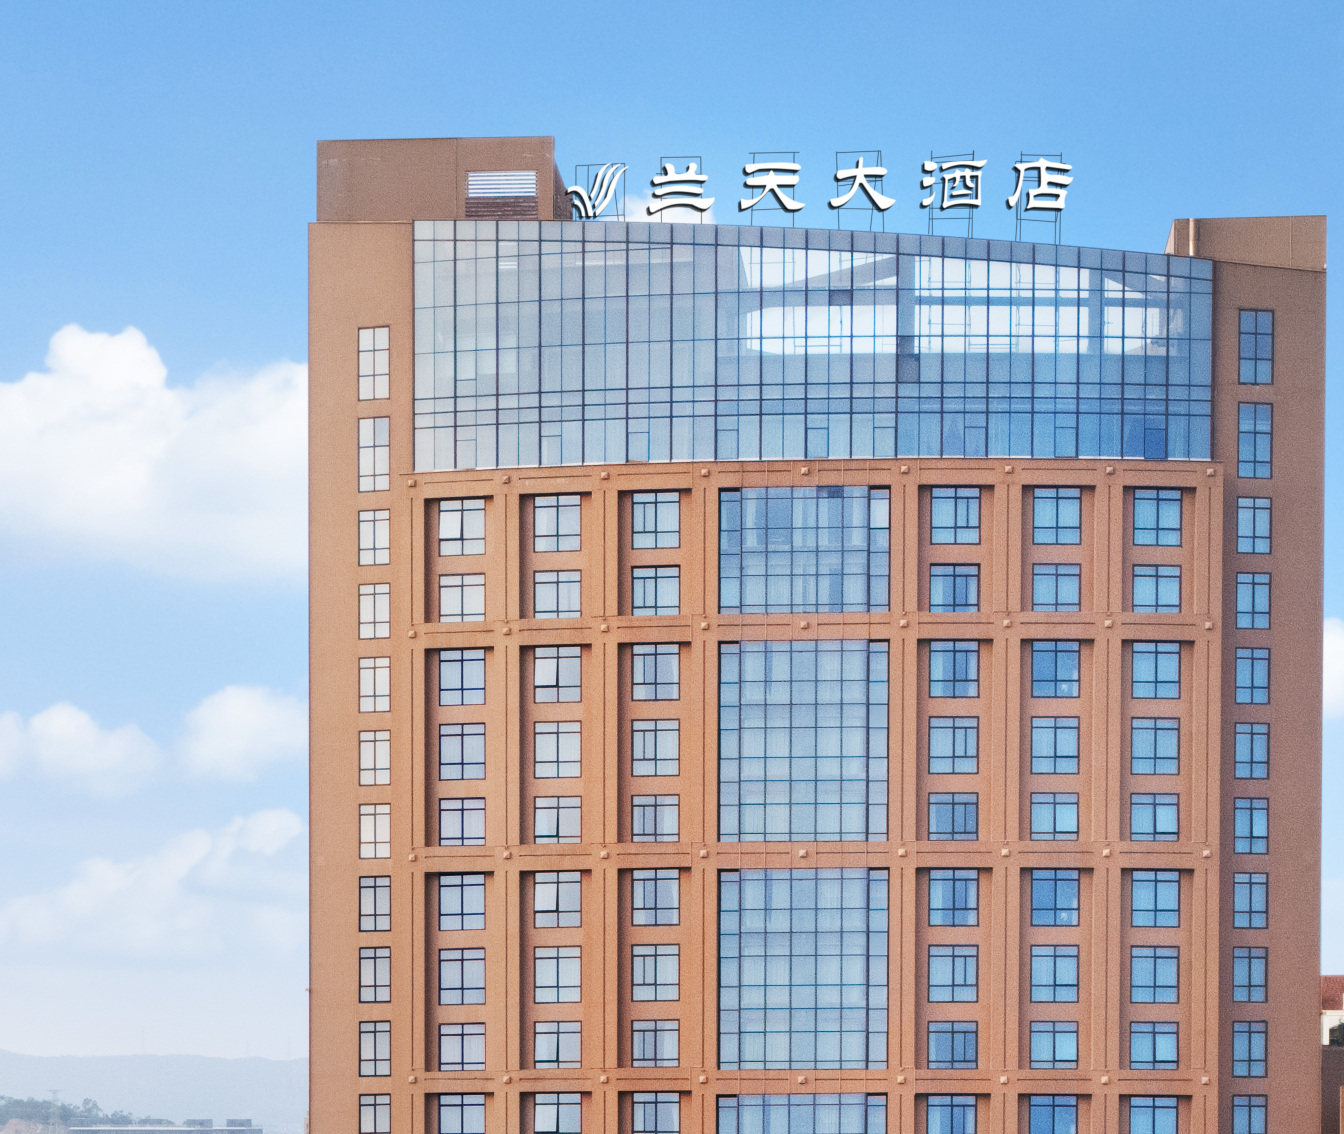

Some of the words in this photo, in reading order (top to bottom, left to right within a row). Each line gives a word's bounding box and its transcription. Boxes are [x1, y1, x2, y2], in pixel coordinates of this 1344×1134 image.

[647, 156, 1074, 213] 兰天大酒店
